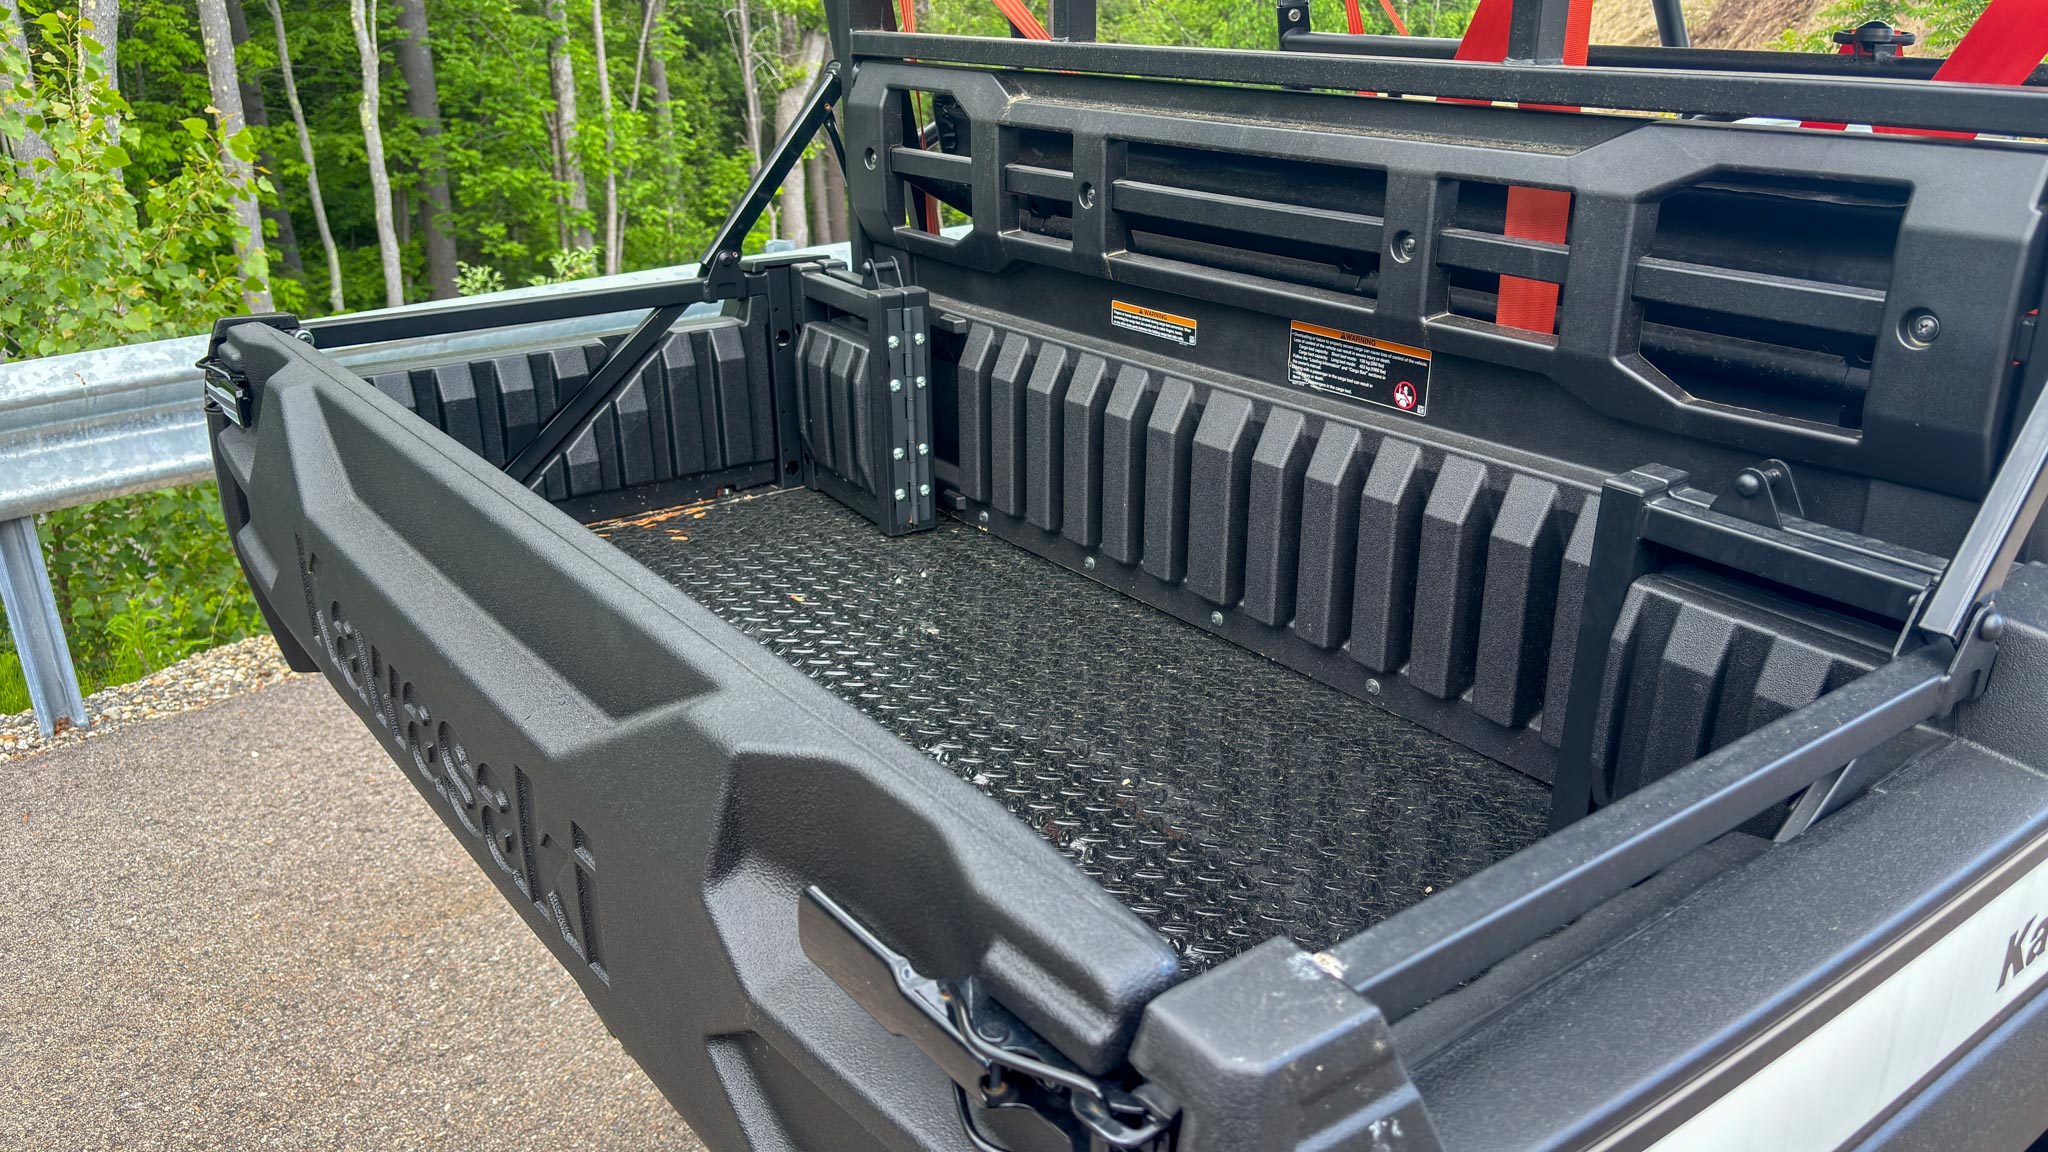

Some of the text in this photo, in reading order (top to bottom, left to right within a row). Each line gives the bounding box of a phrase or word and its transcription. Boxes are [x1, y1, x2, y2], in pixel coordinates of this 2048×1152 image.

[1143, 309, 1168, 319] WARNING
[1345, 334, 1376, 346] WARNING
[295, 533, 611, 988] Kawasaki
